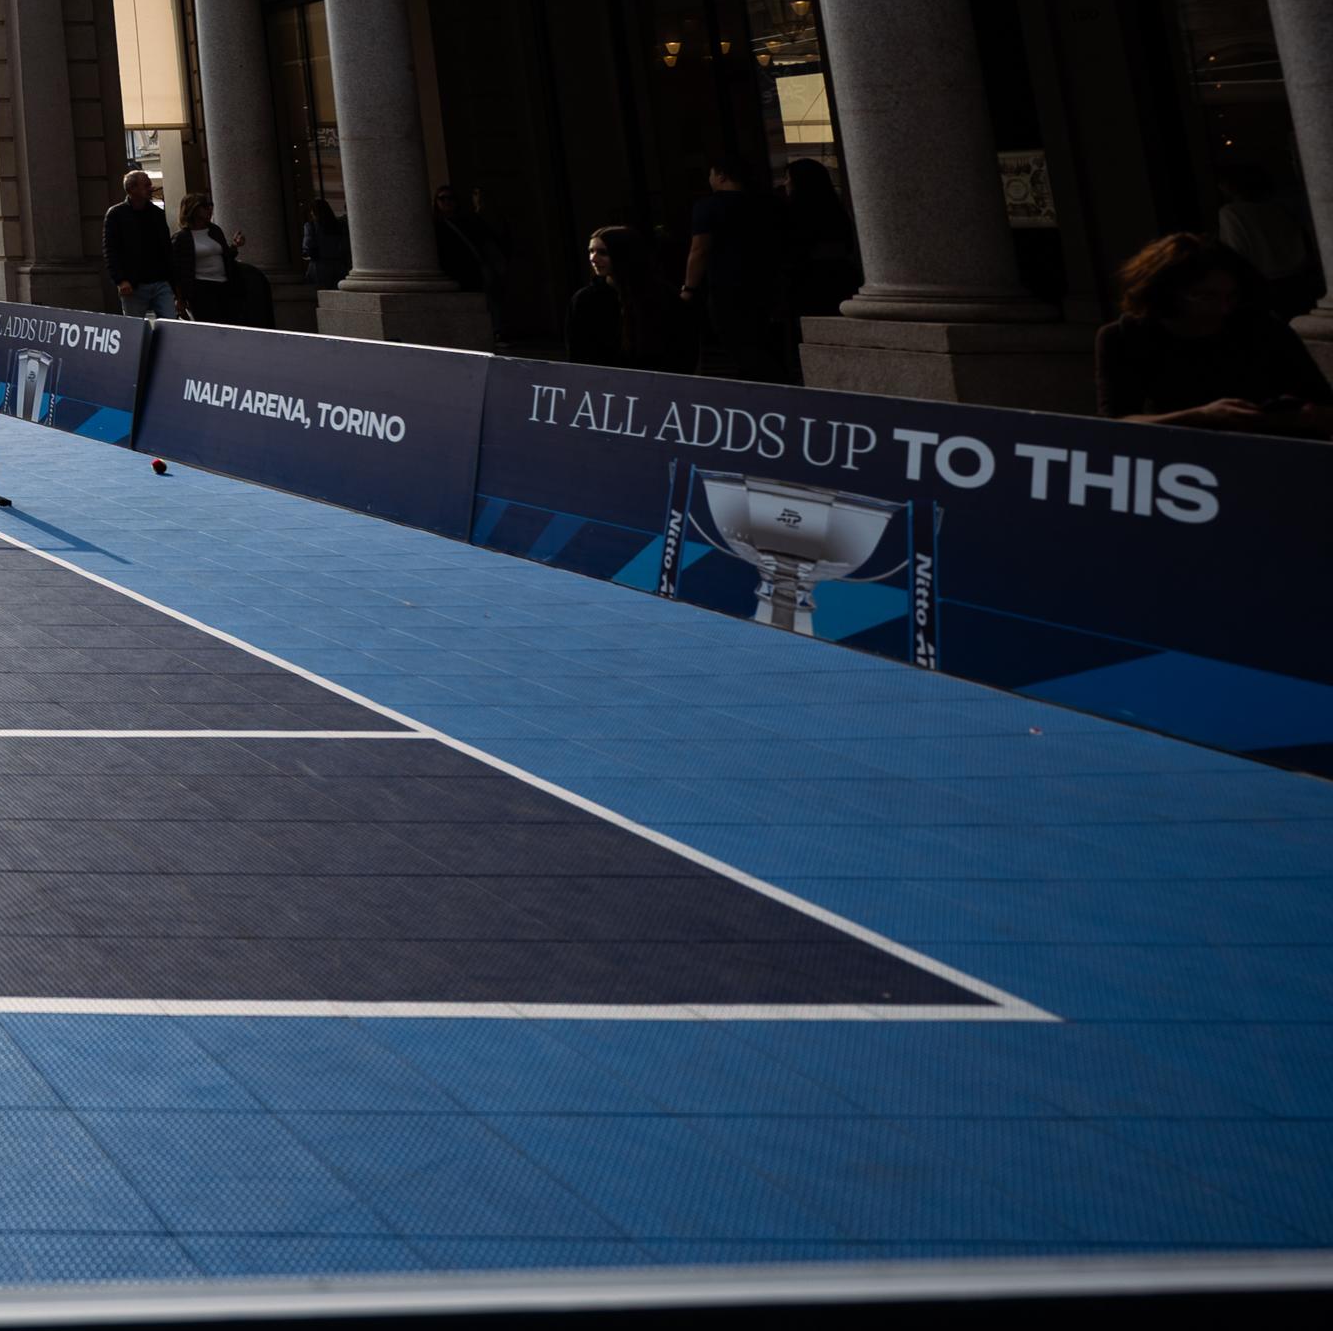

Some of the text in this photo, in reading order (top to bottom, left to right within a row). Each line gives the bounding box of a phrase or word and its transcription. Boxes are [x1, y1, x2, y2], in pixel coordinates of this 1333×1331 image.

[4, 315, 37, 341] ADDS
[38, 319, 57, 344] UP
[59, 322, 81, 348] TO
[83, 325, 122, 355] THIS
[183, 378, 406, 443] INALPI ARENA, TORINO
[528, 384, 1220, 525] IT ALL ADDS UP TO THIS
[663, 508, 683, 570] Nitto
[914, 551, 934, 628] Nitto
